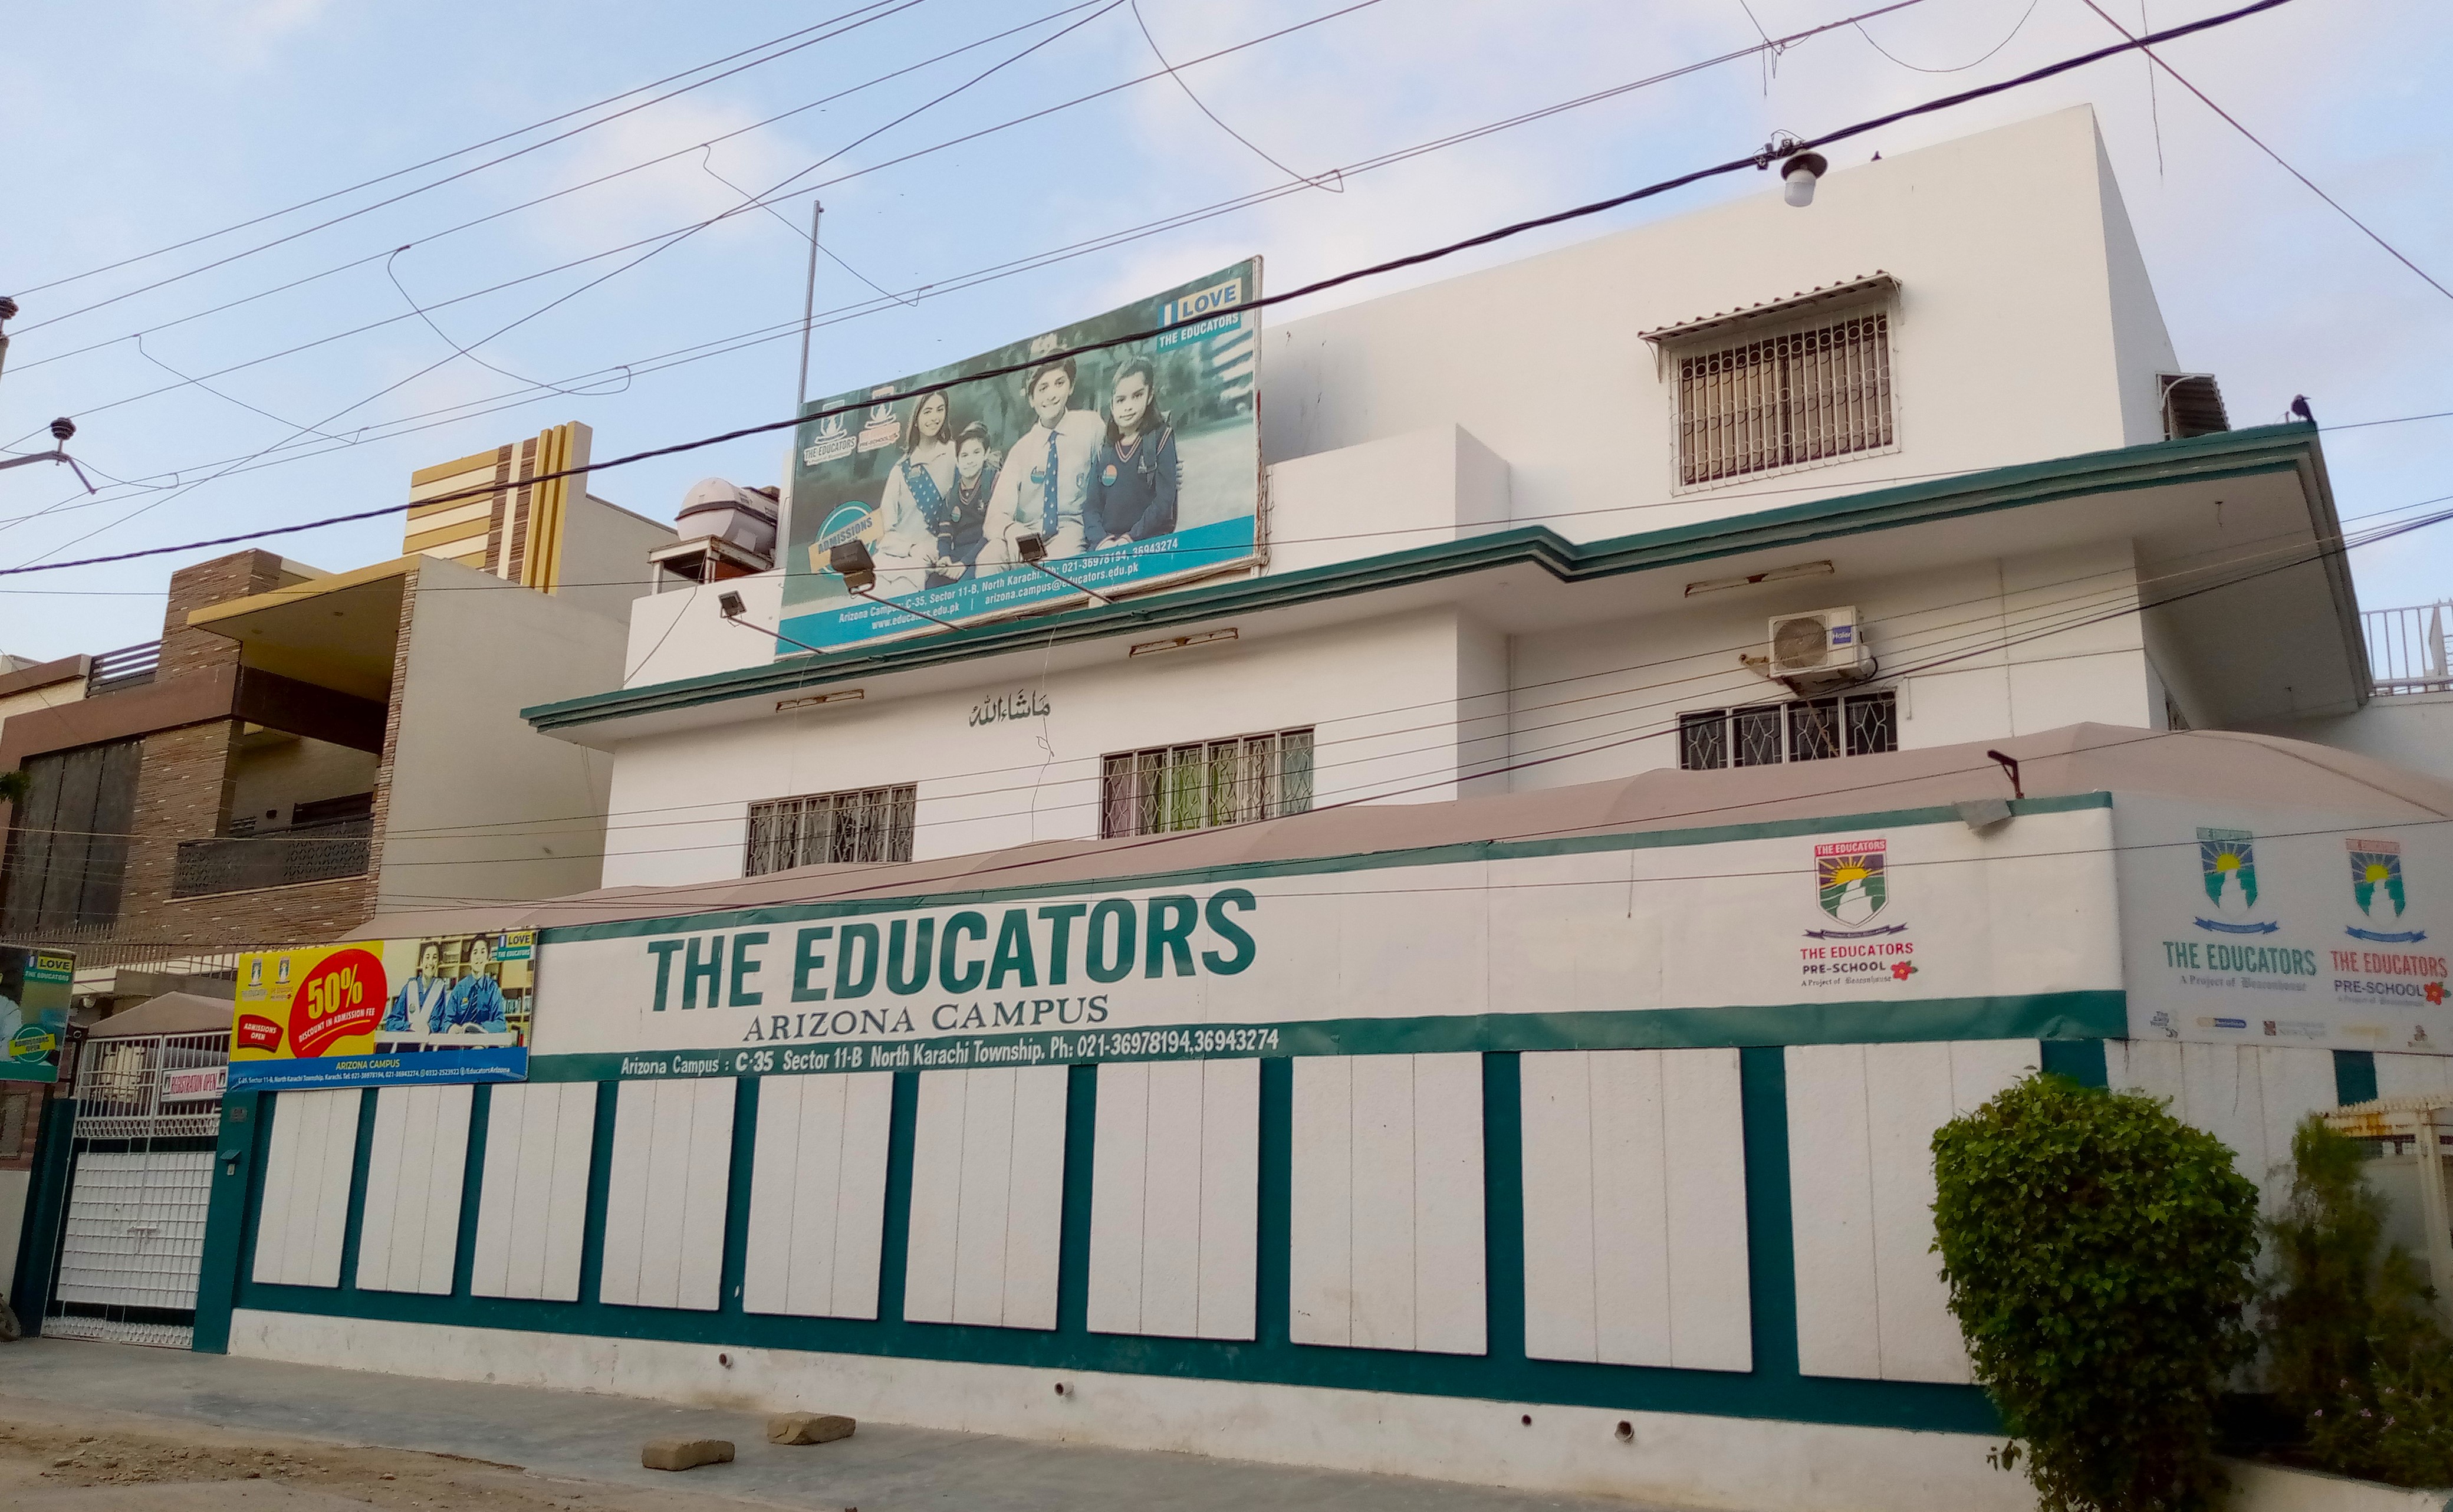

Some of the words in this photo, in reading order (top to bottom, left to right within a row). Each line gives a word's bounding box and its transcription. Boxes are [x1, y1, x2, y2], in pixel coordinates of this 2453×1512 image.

[1182, 284, 1237, 317] LOVE
[1159, 331, 1178, 348] THE
[1181, 314, 1239, 340] EDUCATORS
[804, 448, 817, 460] THE
[818, 438, 856, 456] EDUCATORS
[818, 517, 873, 554] ADMISSIONS
[839, 610, 868, 623] Arizona
[869, 603, 904, 617] Camp:
[905, 596, 928, 609] C-35,
[929, 590, 956, 604] Sector
[982, 577, 1005, 592] North
[1132, 538, 1178, 558] 36943274
[872, 602, 960, 630] www.educas.edu.pk
[1816, 844, 1834, 855] THE
[1835, 840, 1886, 854] EDUCATORS
[508, 935, 531, 945] LOVE
[647, 931, 770, 1012] THE
[791, 887, 1257, 1003] EDUCATORS
[1800, 946, 1826, 960] THE
[1830, 942, 1914, 958] EDUCATORS
[40, 958, 71, 970] LOVE
[1802, 961, 1886, 975] PRE-SCHOOL
[2162, 941, 2201, 969] THE
[2205, 944, 2317, 976] EDUCATORS
[2330, 950, 2359, 972] THE
[2363, 952, 2448, 978] EDUCATORS
[308, 963, 363, 1020] 50%
[1808, 979, 1832, 987] Project
[2333, 979, 2424, 997] PRE-SCHOOL
[243, 1023, 277, 1034] ADMISSIONS
[298, 1021, 325, 1043] DISCOUNT
[325, 1018, 333, 1027] IN
[334, 1008, 365, 1024] ADMISSION
[366, 1007, 376, 1017] FEE
[742, 1004, 916, 1043] ARIZONA
[931, 994, 1109, 1031] CAMPUS
[251, 1032, 266, 1040] OPEN
[336, 1061, 368, 1070] ARIZONA
[369, 1059, 400, 1069] CAMPUS
[620, 1056, 667, 1076] Arizona
[672, 1054, 720, 1077] Campus
[735, 1049, 775, 1073] C-35
[782, 1048, 830, 1071] Sector
[833, 1044, 864, 1069] 11-B
[870, 1043, 910, 1069] North
[913, 1040, 971, 1066] Karachi
[1050, 1035, 1074, 1060] Ph:
